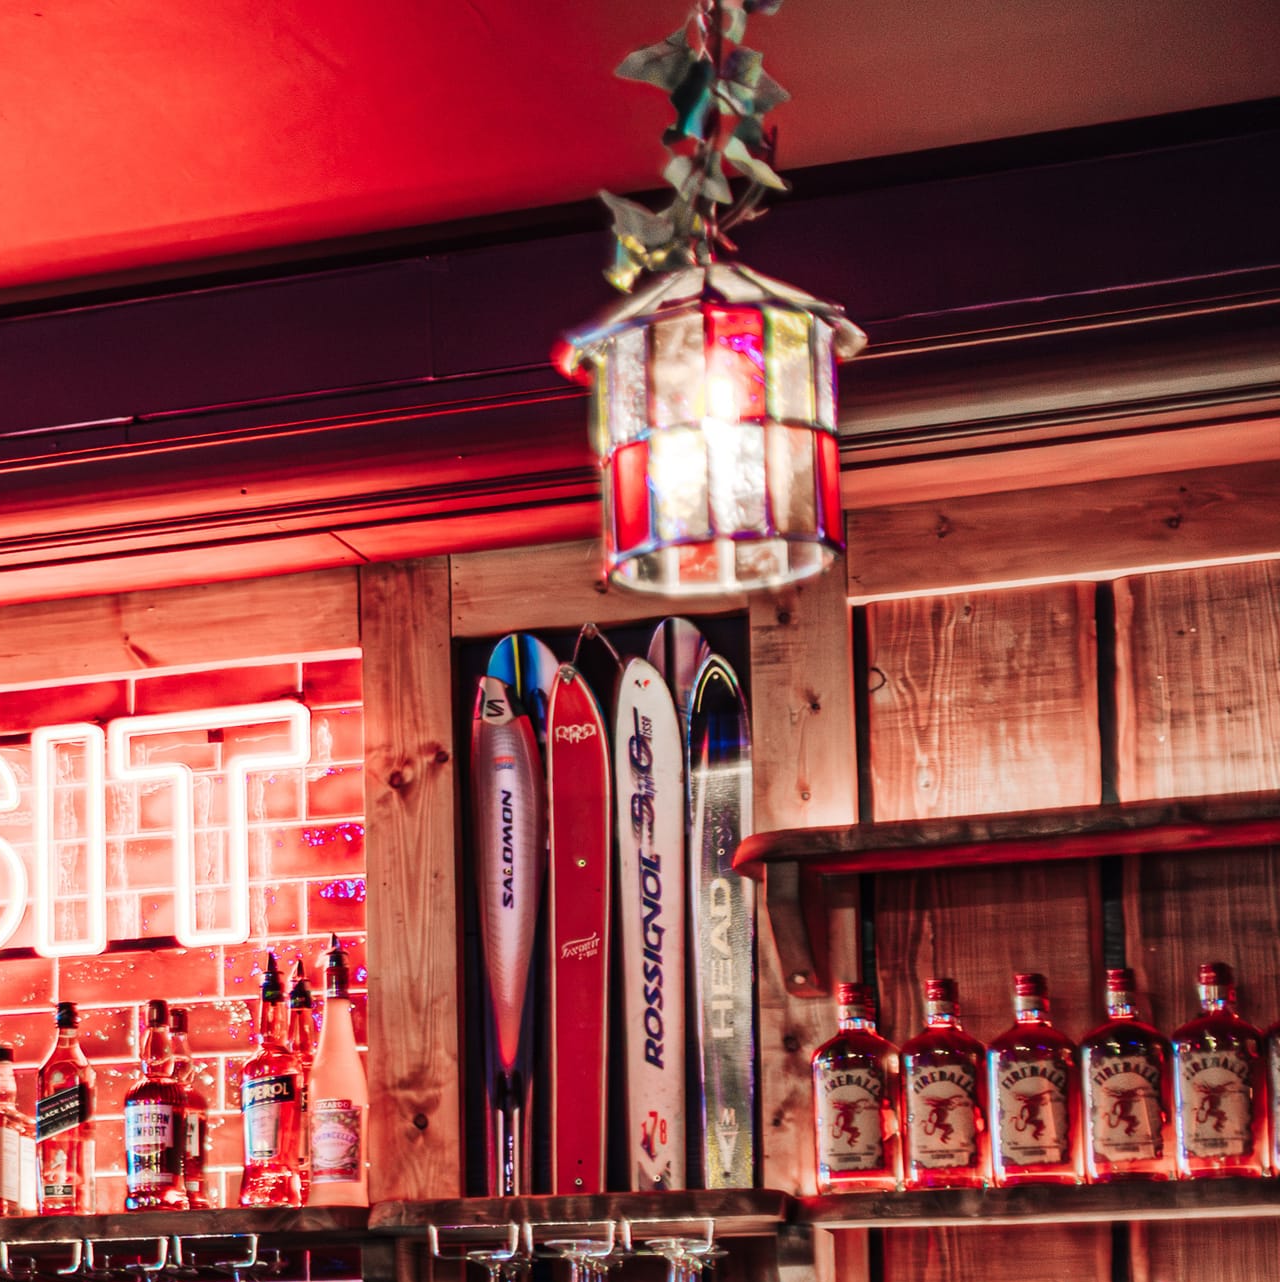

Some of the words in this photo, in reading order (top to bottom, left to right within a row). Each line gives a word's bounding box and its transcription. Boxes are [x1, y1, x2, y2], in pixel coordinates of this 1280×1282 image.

[502, 789, 516, 909] SALOMON
[638, 851, 666, 1070] ROSSIGNOL
[709, 877, 734, 1039] HEAD
[1002, 1066, 1065, 1090] FIREBALL
